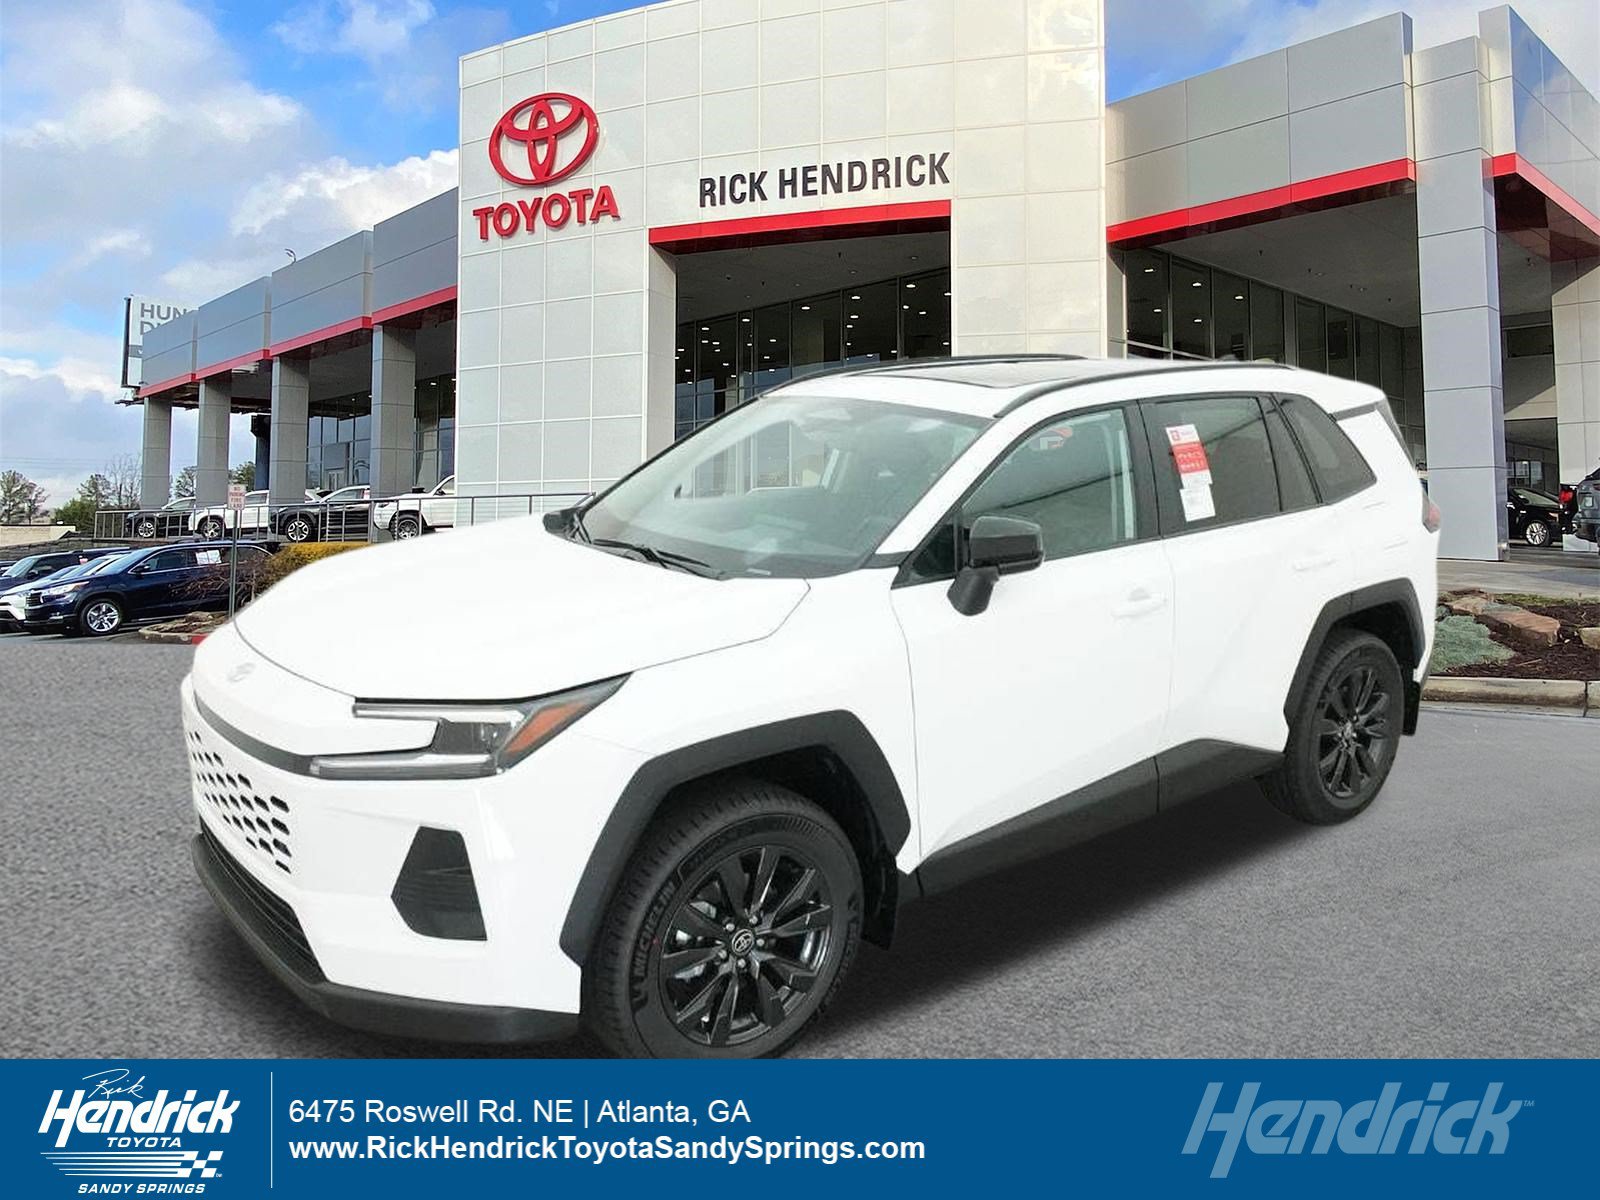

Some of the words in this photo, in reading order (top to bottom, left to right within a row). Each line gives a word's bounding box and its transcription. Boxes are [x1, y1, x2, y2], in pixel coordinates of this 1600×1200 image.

[699, 170, 769, 208] RICK
[779, 151, 951, 200] HENDRICK
[473, 185, 622, 241] TOYOTA
